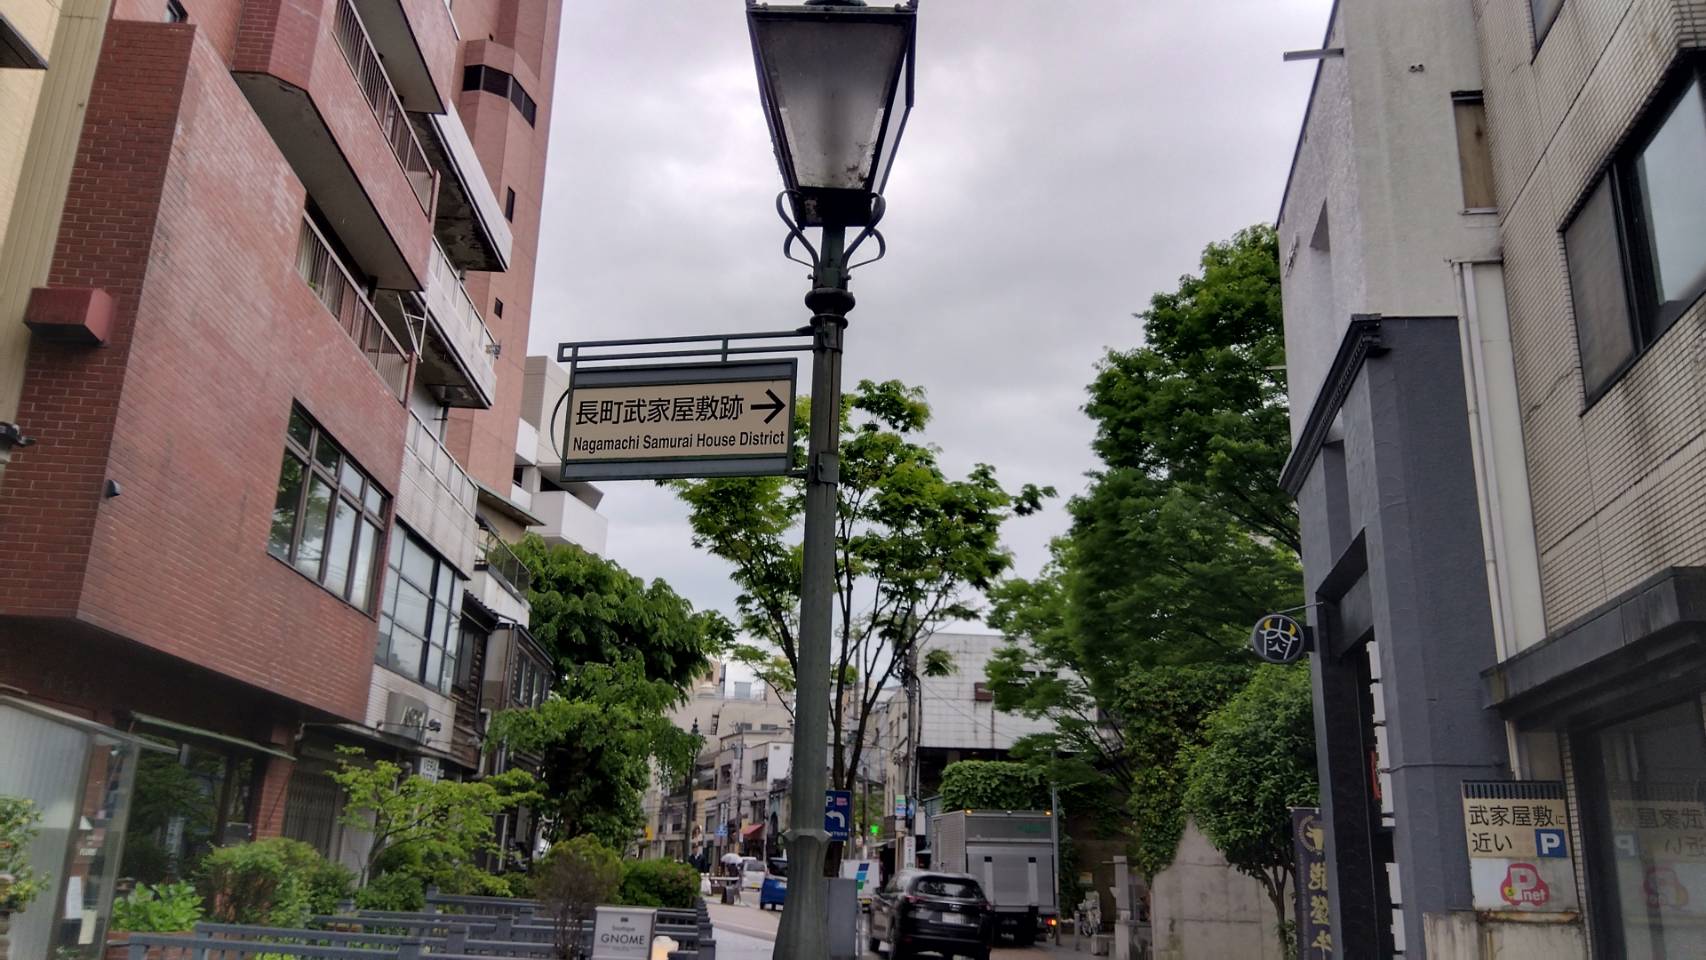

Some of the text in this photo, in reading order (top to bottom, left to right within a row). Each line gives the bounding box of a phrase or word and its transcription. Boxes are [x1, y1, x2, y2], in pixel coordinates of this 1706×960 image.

[576, 394, 744, 425] 長町武家屋敷跡
[573, 430, 785, 454] Nagamachi Samurai House District
[1469, 804, 1566, 827] 武家屋敷に
[1472, 832, 1513, 853] 近い
[1540, 833, 1561, 855] P
[600, 933, 645, 945] GNOME
